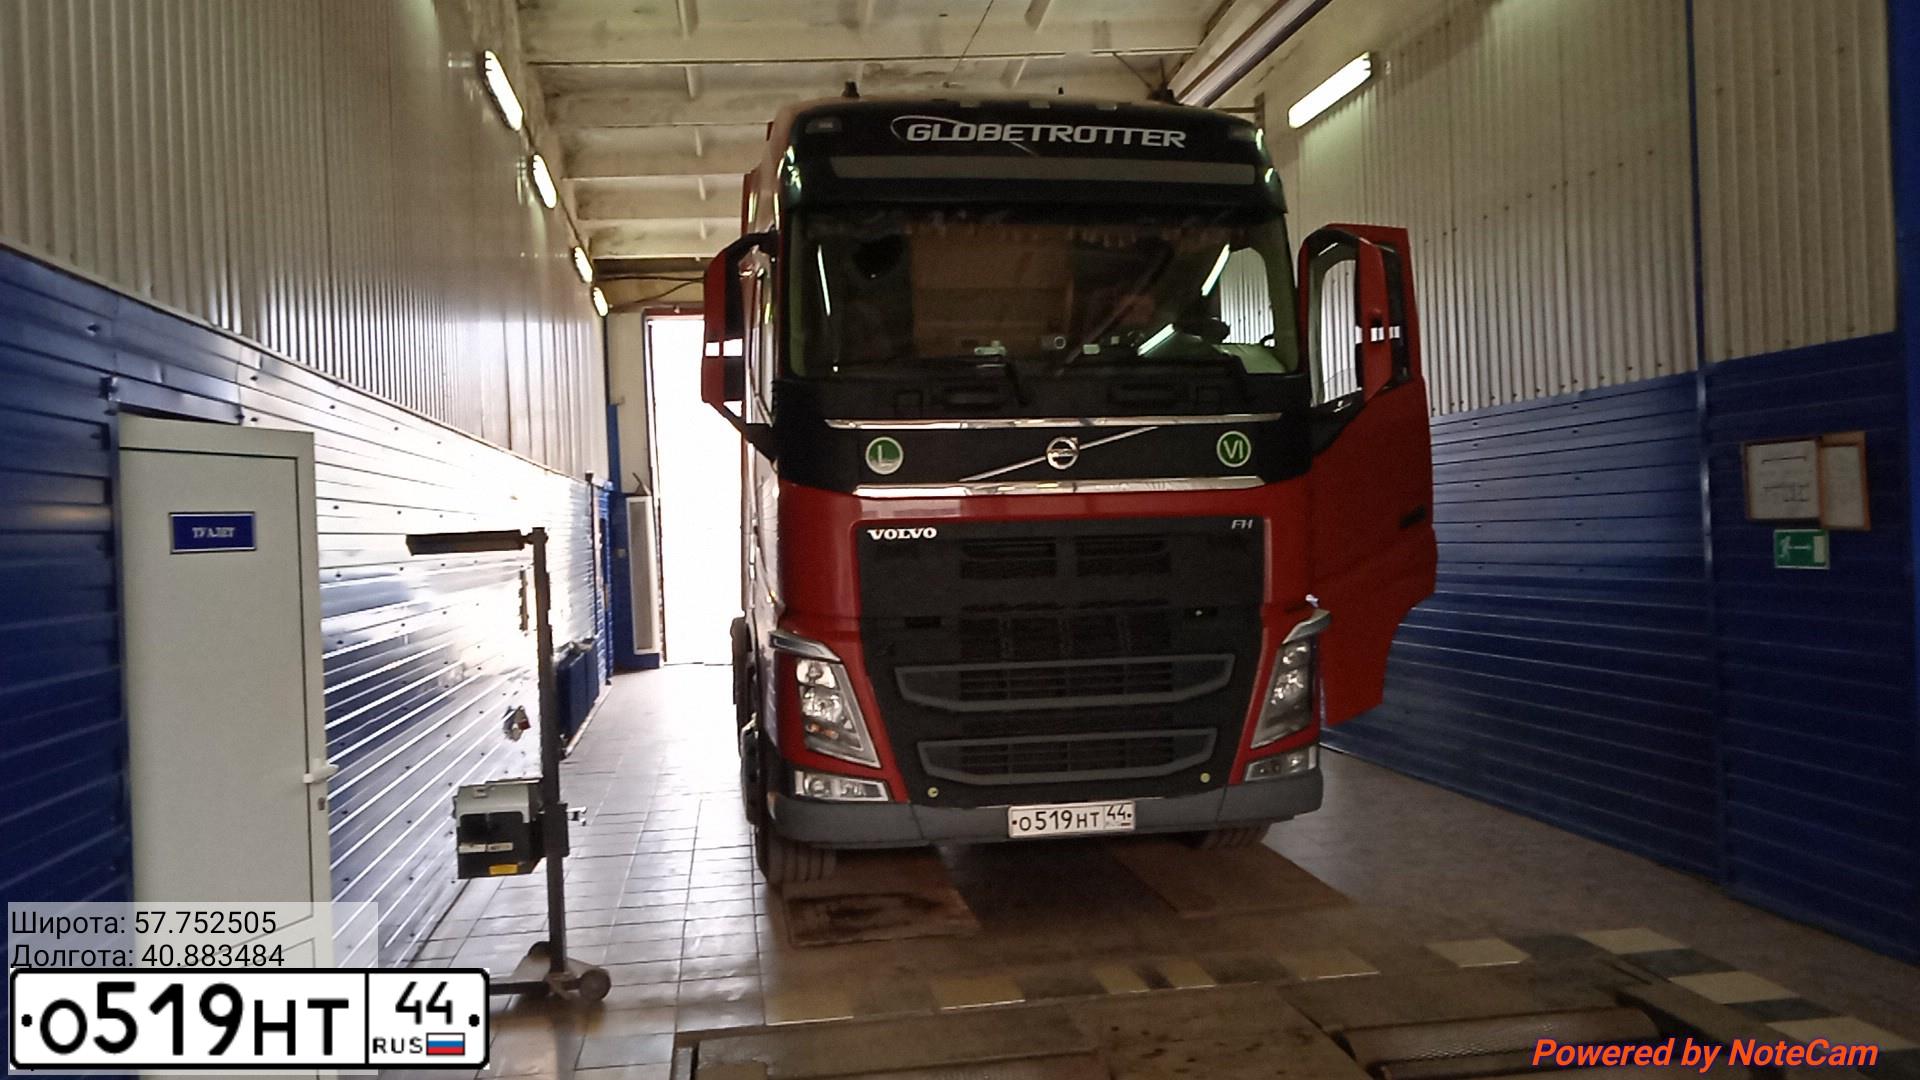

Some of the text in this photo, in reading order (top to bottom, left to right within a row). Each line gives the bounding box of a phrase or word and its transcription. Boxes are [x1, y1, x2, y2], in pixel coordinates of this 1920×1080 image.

[906, 122, 1187, 148] GLOBETROTTER
[1222, 440, 1244, 459] VI
[1231, 518, 1254, 530] FH
[867, 527, 938, 540] VOLVO
[1106, 804, 1126, 820] 44
